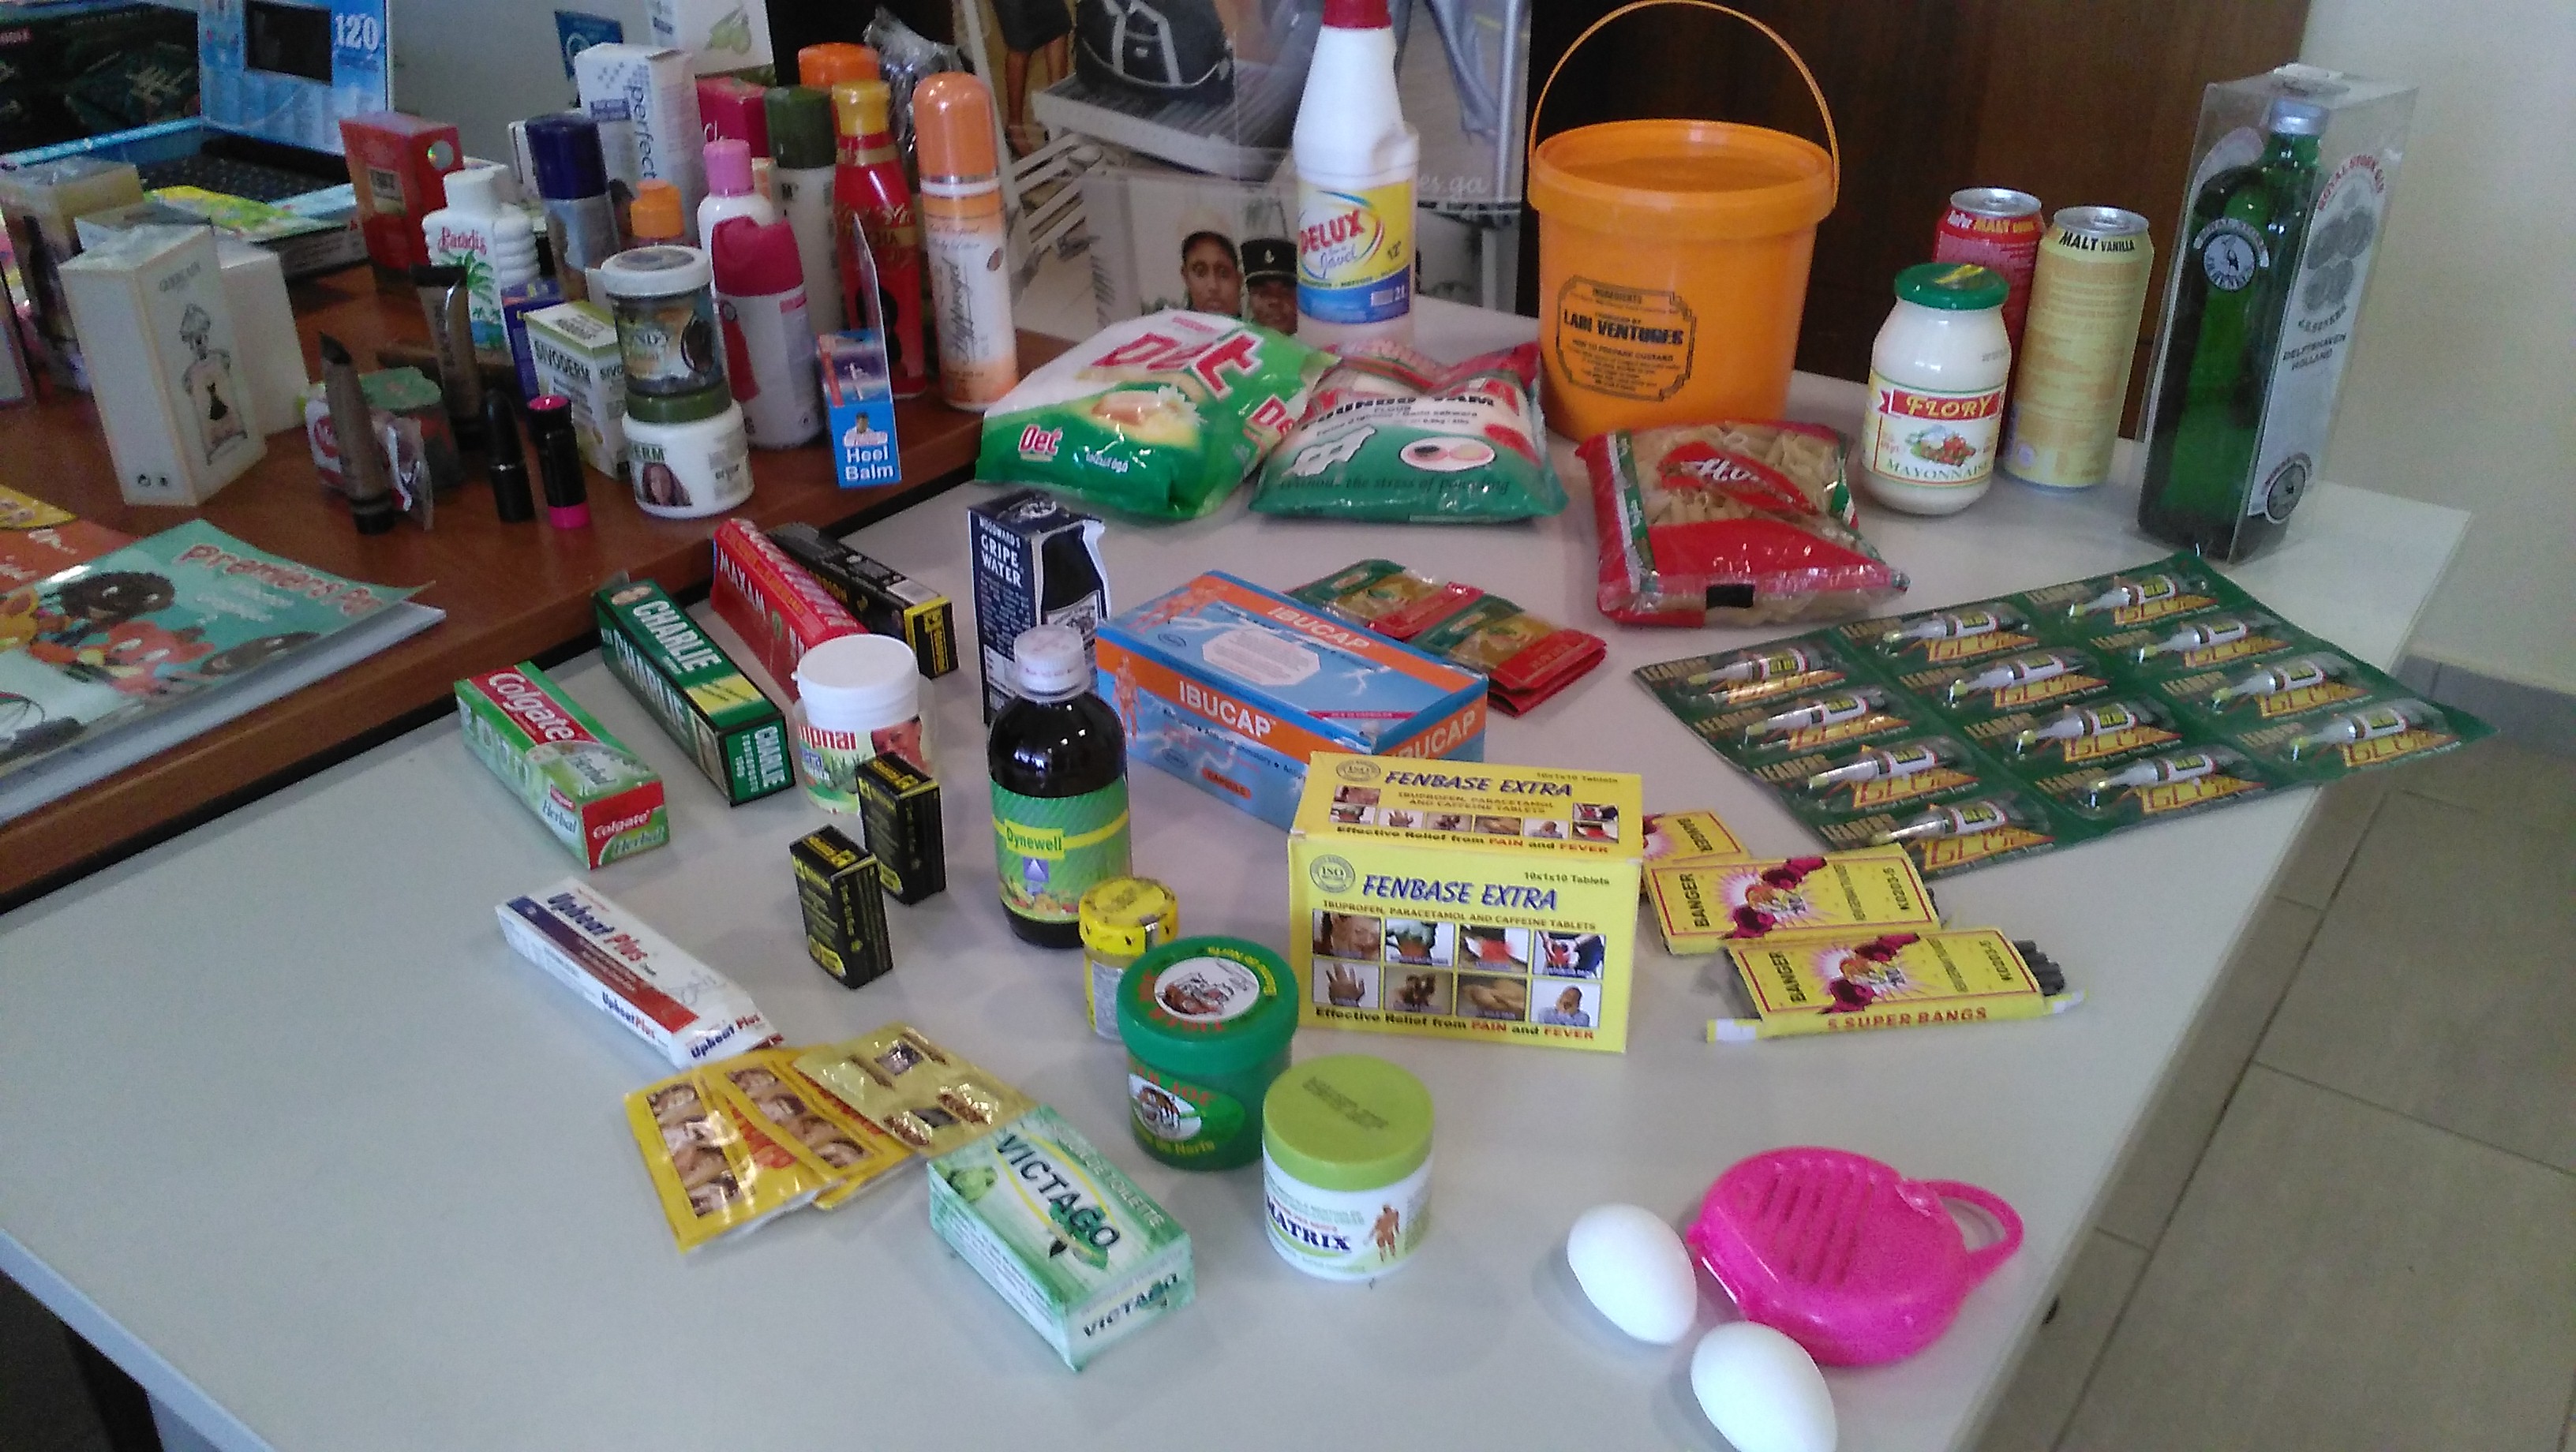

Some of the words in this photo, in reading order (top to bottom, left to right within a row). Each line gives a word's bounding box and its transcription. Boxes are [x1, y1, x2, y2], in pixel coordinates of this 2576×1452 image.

[334, 13, 380, 51] 120
[623, 84, 657, 179] perfect
[1298, 210, 1365, 255] DELUX
[2059, 231, 2099, 251] MALT
[2101, 241, 2135, 252] VANILLA
[1907, 395, 1993, 417] FLORY
[844, 464, 894, 481] Balm
[981, 533, 1019, 567] GRIPE
[719, 547, 766, 620] MAXAM
[981, 551, 1022, 589] WATER
[633, 600, 722, 672] CHARLIE
[1267, 606, 1369, 649] IBUCAP
[489, 672, 575, 741] Colgate
[1179, 680, 1271, 738] IBUCAP
[1384, 770, 1492, 791] FENBASE
[1499, 779, 1574, 798] EXTRA
[542, 799, 578, 834] Herbal
[593, 811, 649, 840] Colgate
[1006, 827, 1063, 851] Dynewell
[1336, 825, 1400, 838] Effective
[1405, 831, 1446, 841] Relief
[1451, 834, 1485, 844] from
[1488, 837, 1524, 848] PAIN
[1529, 841, 1555, 850] and
[1559, 843, 1609, 854] FEVER
[1363, 874, 1473, 905] FENBASE
[1481, 883, 1559, 911] EXTRA
[1524, 871, 1568, 882] 10x1x10
[1571, 874, 1610, 885] Tablets
[1323, 900, 1385, 915] IBUPROFEN,
[1390, 907, 1465, 922] PARACETAMOL
[1470, 913, 1493, 923] AND
[1496, 915, 1546, 927] CAFFEINE
[1549, 919, 1597, 930] TABLETS
[1679, 873, 1710, 927] BANGER
[1769, 950, 1807, 1003] BANGER
[736, 1012, 761, 1031] Plus
[1315, 1007, 1381, 1024] Effective
[1384, 1014, 1428, 1027] Relief
[1433, 1018, 1467, 1030] from
[1471, 1021, 1507, 1033] PAIN
[1511, 1025, 1539, 1036] and
[1544, 1027, 1594, 1040] FEVER
[1844, 1013, 1911, 1030] SUPER
[1919, 1006, 1987, 1024] BANGS
[997, 1134, 1121, 1247] VICTAGO
